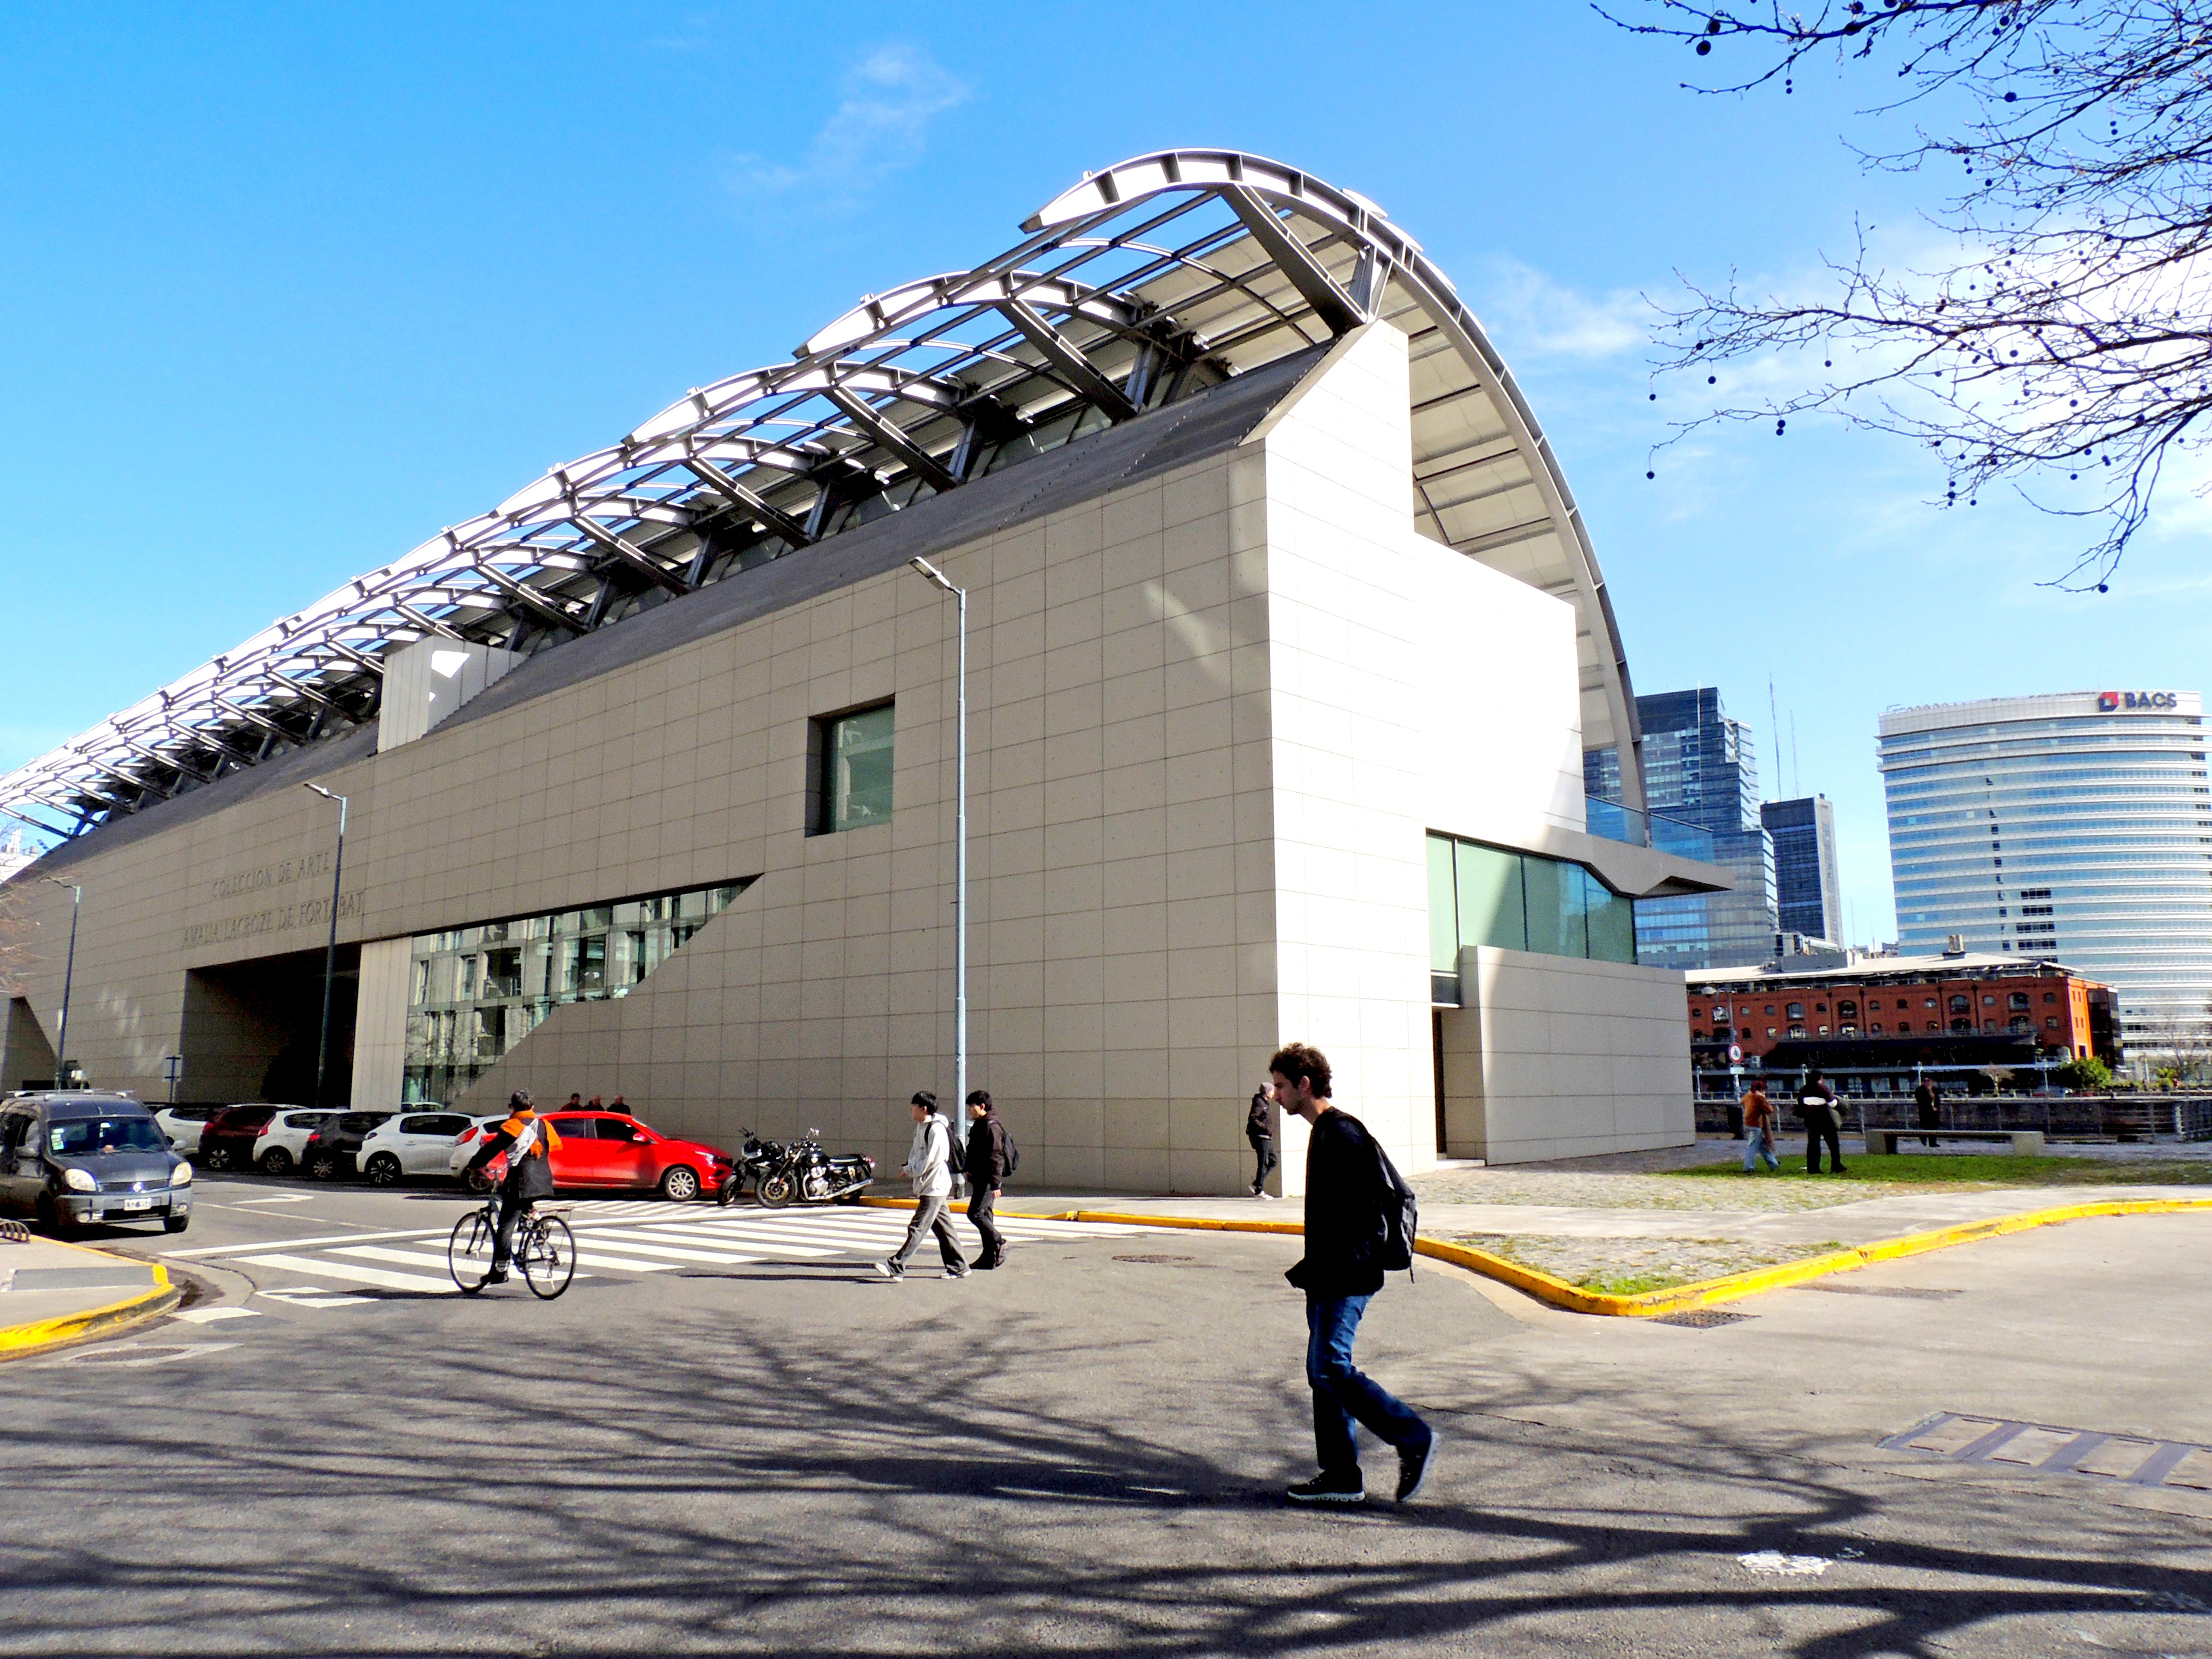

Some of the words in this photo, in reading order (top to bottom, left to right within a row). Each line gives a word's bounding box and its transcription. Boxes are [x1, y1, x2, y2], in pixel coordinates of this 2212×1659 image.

[2125, 692, 2177, 708] BACS
[278, 862, 291, 882] DE
[298, 852, 330, 878] ARTE
[278, 907, 293, 930] DE
[299, 891, 363, 925] FORTBAT
